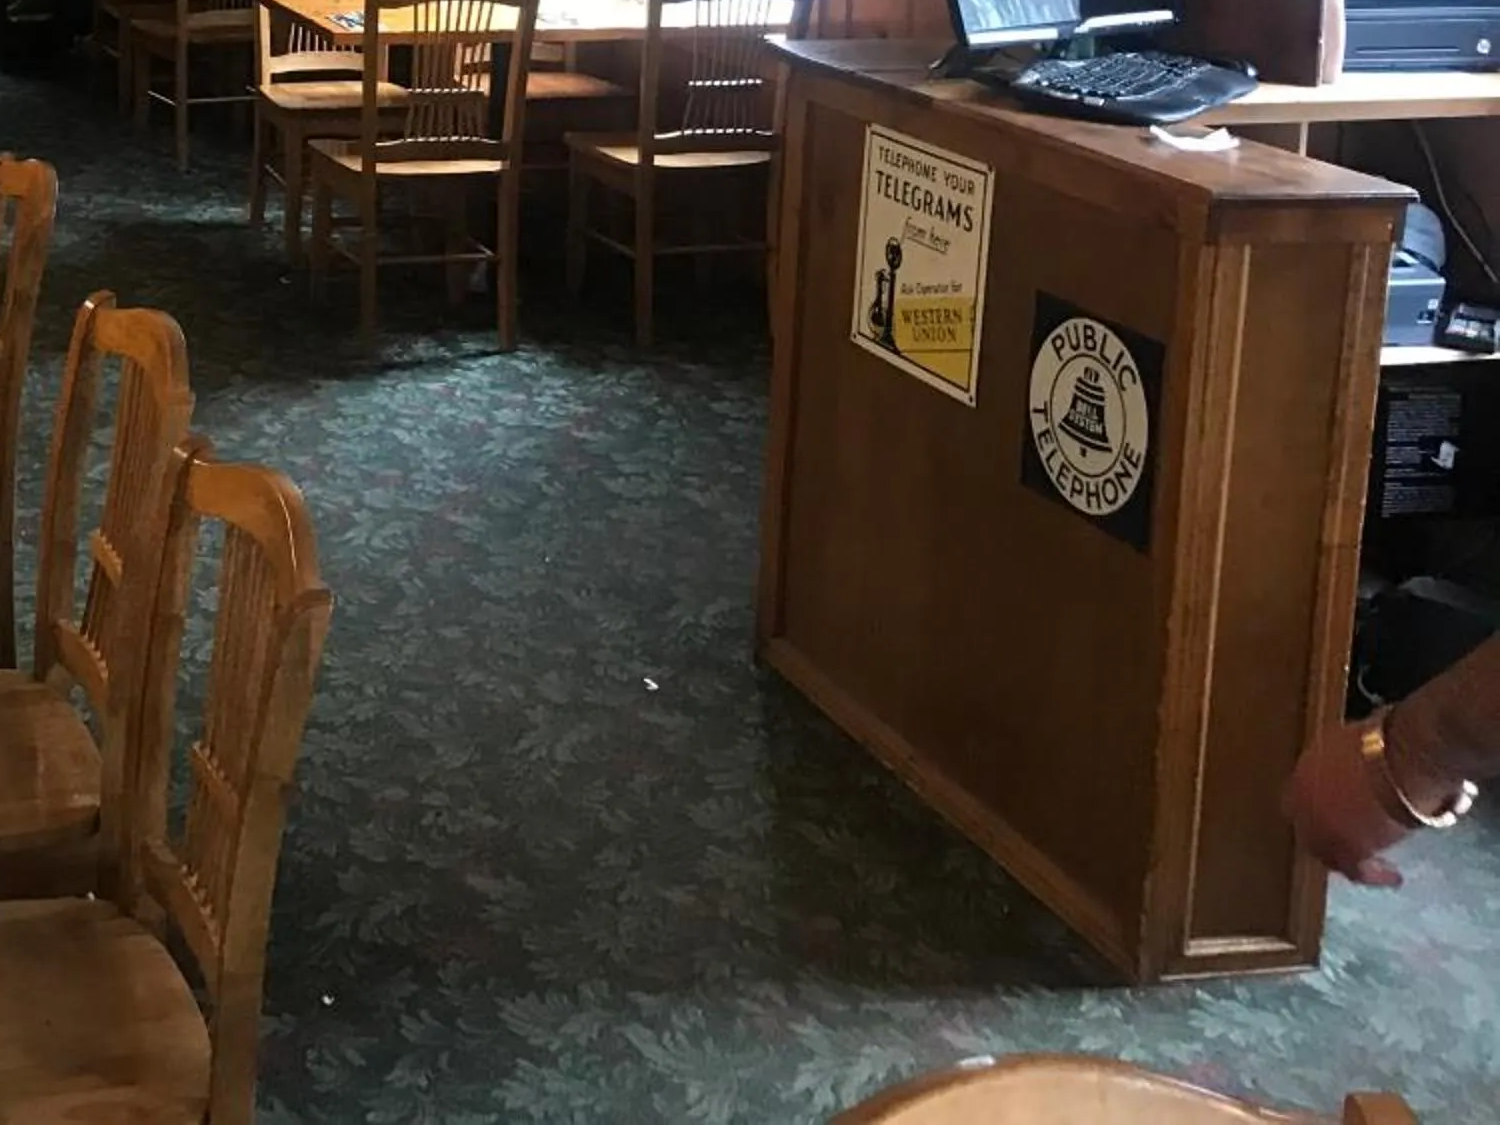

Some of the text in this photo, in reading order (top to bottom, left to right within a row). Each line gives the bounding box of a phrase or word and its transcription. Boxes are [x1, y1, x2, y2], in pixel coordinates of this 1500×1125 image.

[880, 146, 975, 195] TELEPHONE YOUR
[875, 169, 974, 232] TELEGRAMS
[901, 307, 963, 325] WESTERN
[912, 326, 957, 343] UNION
[1051, 323, 1138, 391] PUBLIC
[1032, 401, 1142, 510] TELEPHONE
